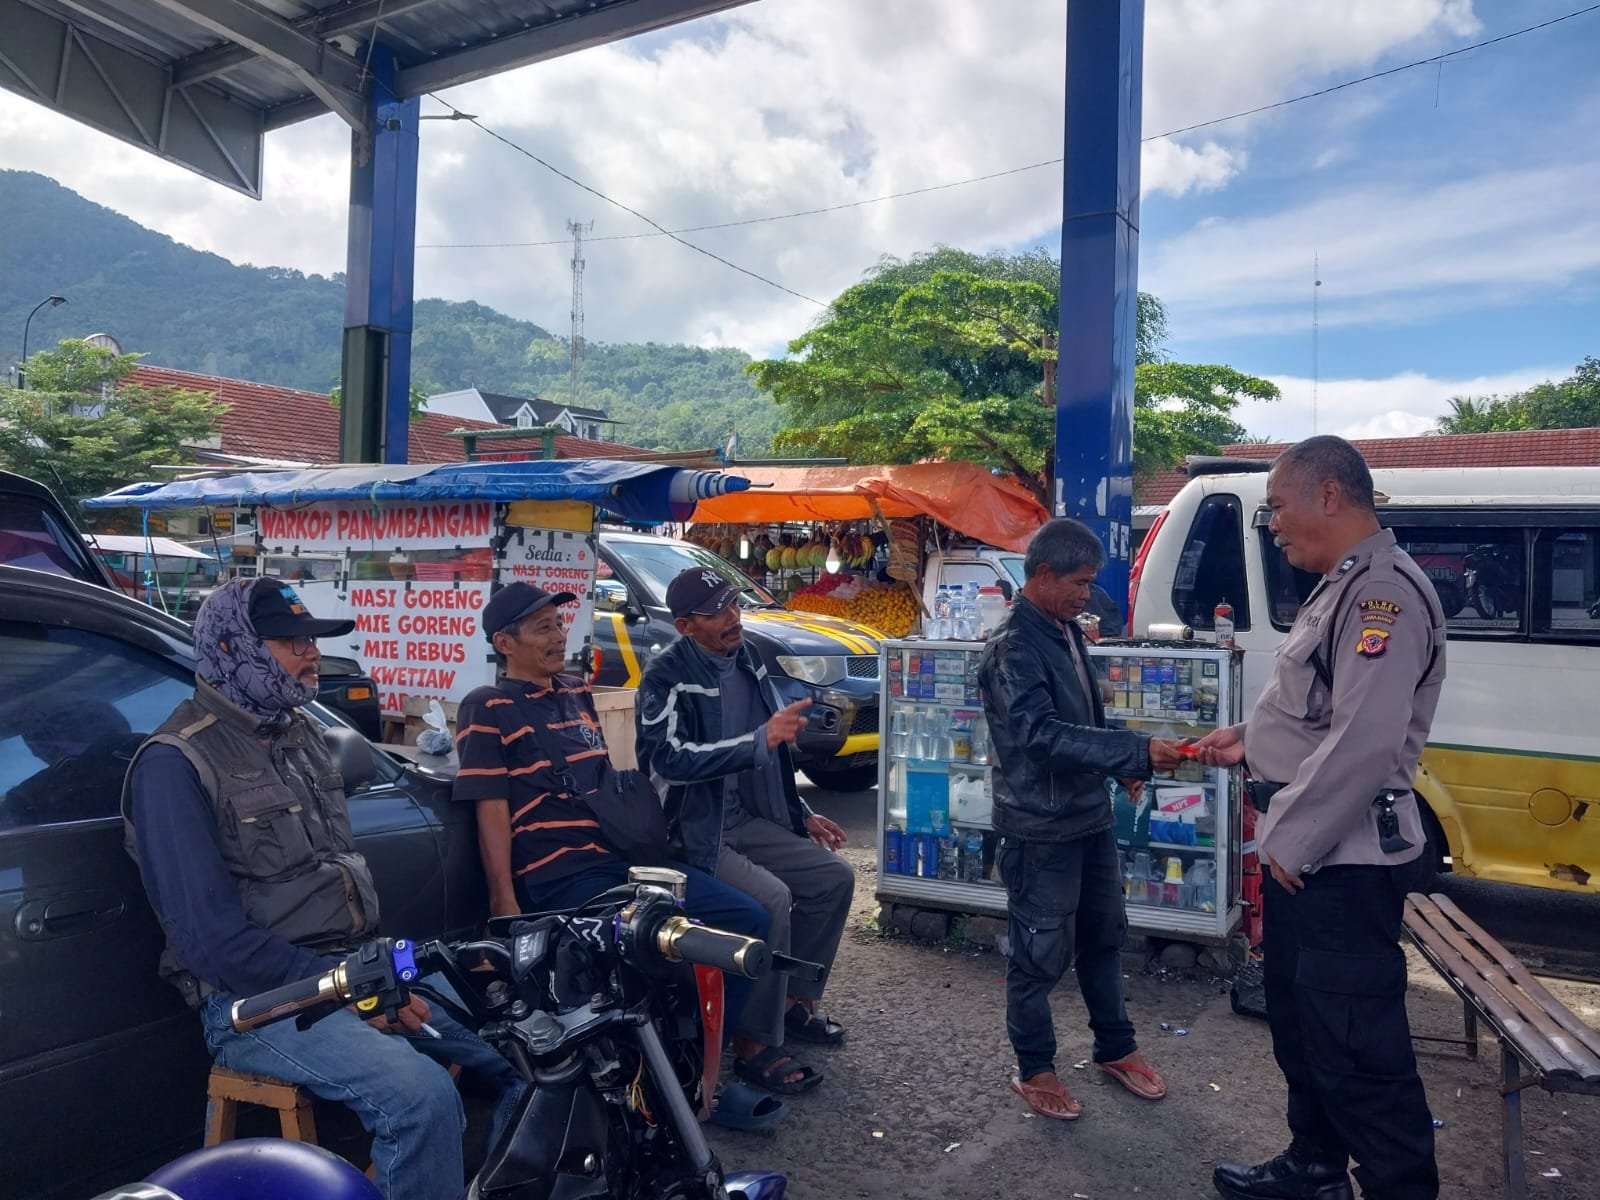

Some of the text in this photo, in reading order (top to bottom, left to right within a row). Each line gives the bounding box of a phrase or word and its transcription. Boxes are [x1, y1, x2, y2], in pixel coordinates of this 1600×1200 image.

[261, 509, 332, 540] WARKOP
[337, 503, 491, 540] PANUMBANGAN
[525, 545, 563, 562] Sedia
[513, 564, 589, 580] NASI GORENG
[541, 582, 587, 594] GORENG
[351, 589, 483, 610] NASI GORENG
[355, 613, 476, 637] MIE GORENG
[364, 640, 466, 663] MIE REBUS
[370, 666, 456, 689] KWETIAW
